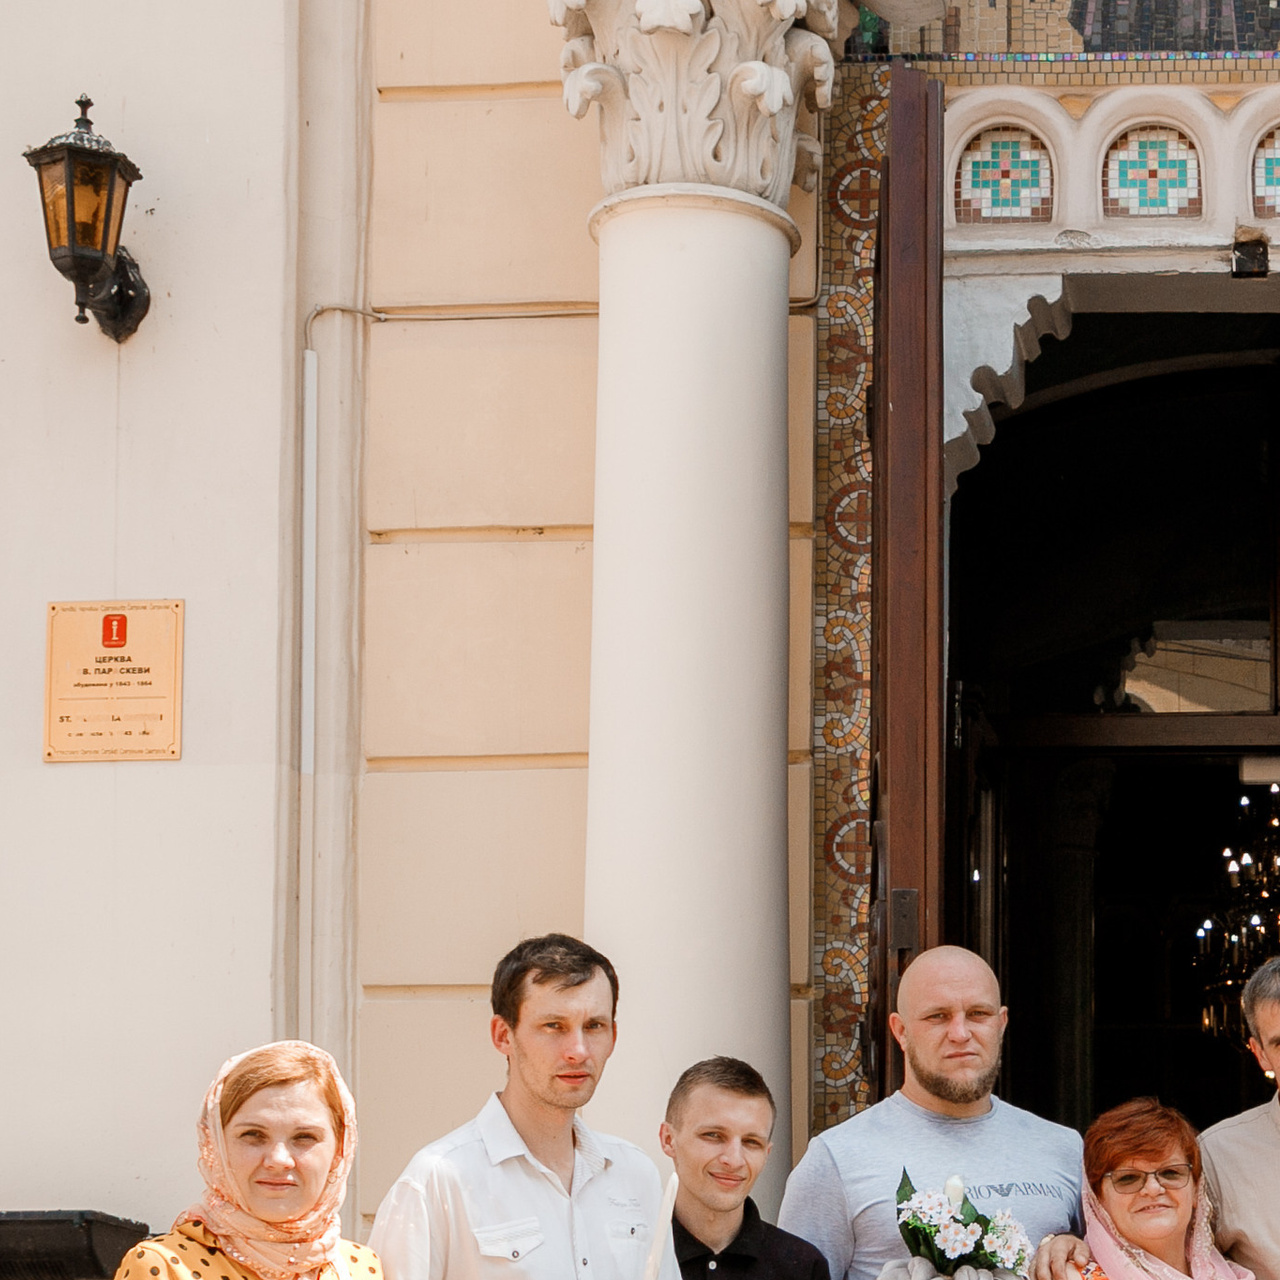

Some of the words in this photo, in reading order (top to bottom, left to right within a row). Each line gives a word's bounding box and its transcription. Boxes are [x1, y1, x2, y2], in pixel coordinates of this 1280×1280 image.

[95, 656, 132, 664] ЦЕРКВА
[94, 667, 150, 675] ПАРСКЕВИ
[1014, 1182, 1064, 1201] ARMAN
